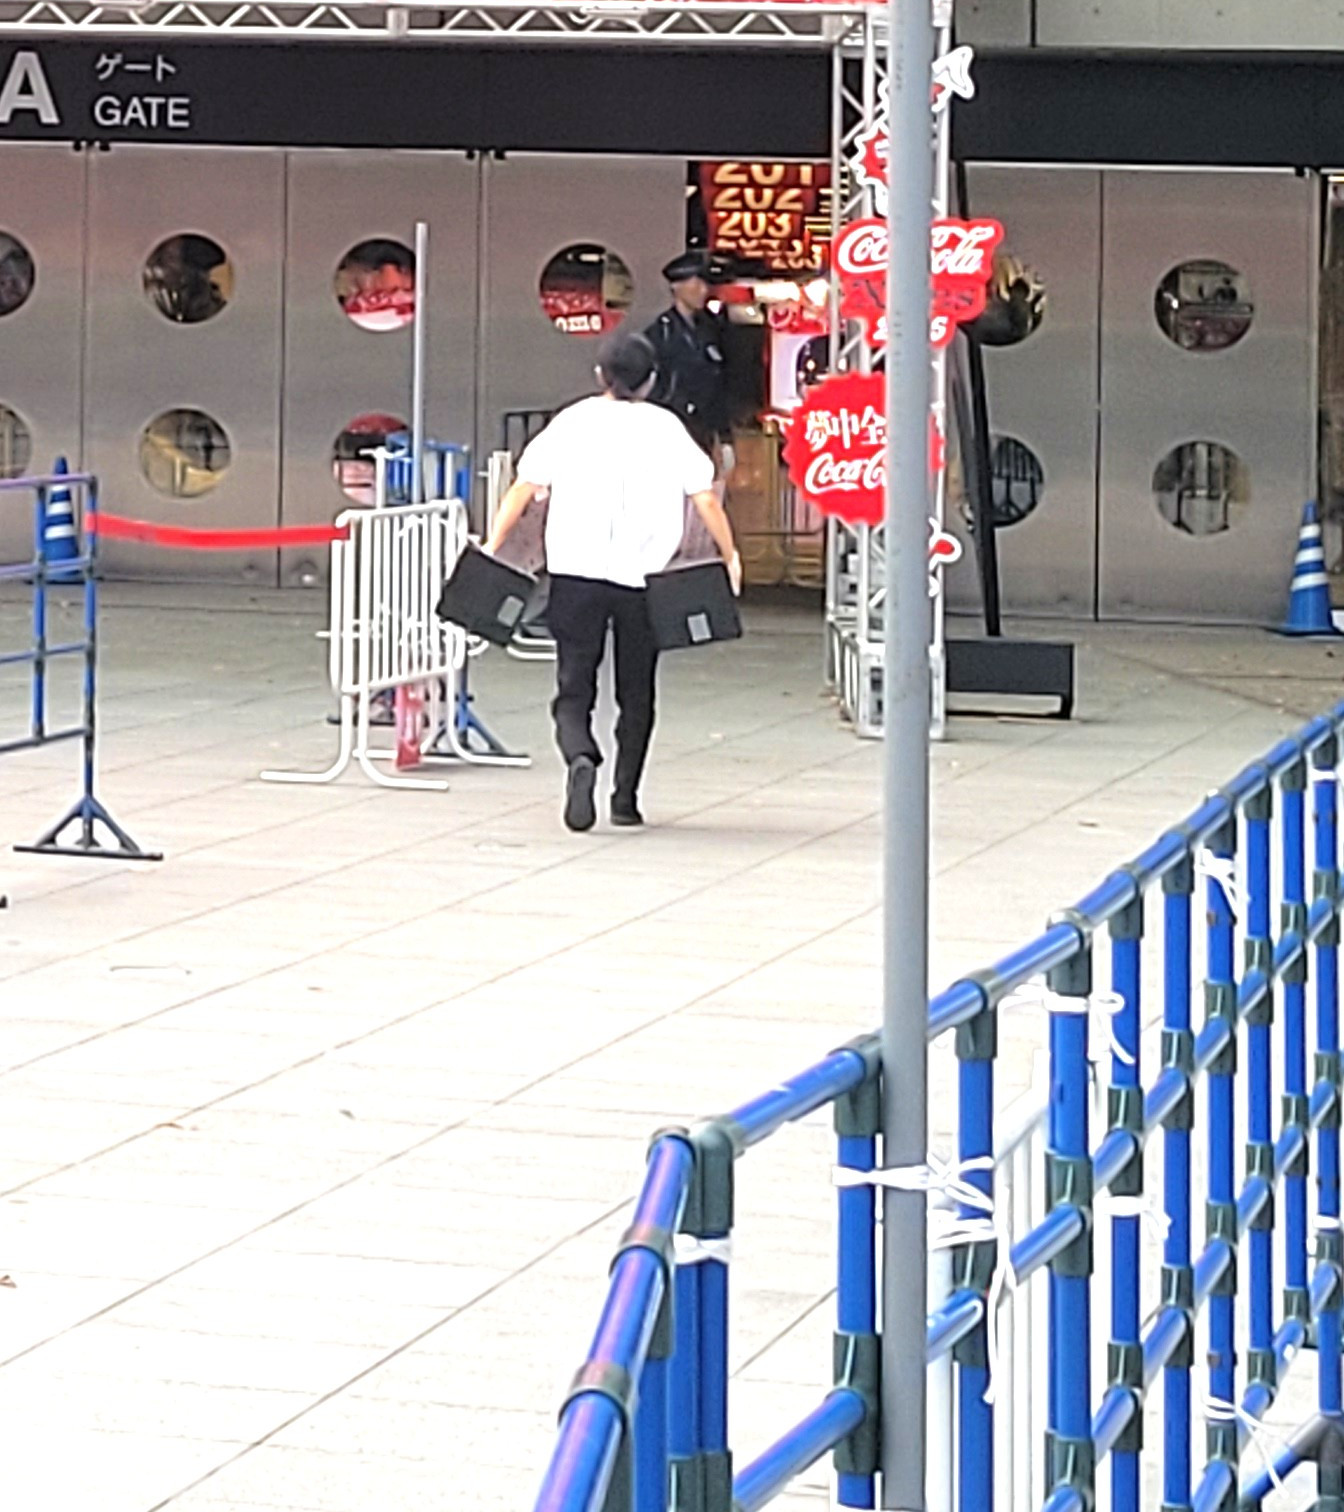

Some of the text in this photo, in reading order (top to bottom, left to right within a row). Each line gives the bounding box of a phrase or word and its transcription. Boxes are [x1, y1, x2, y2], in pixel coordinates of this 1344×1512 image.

[95, 53, 177, 82] ゲート
[94, 95, 190, 128] GATE
